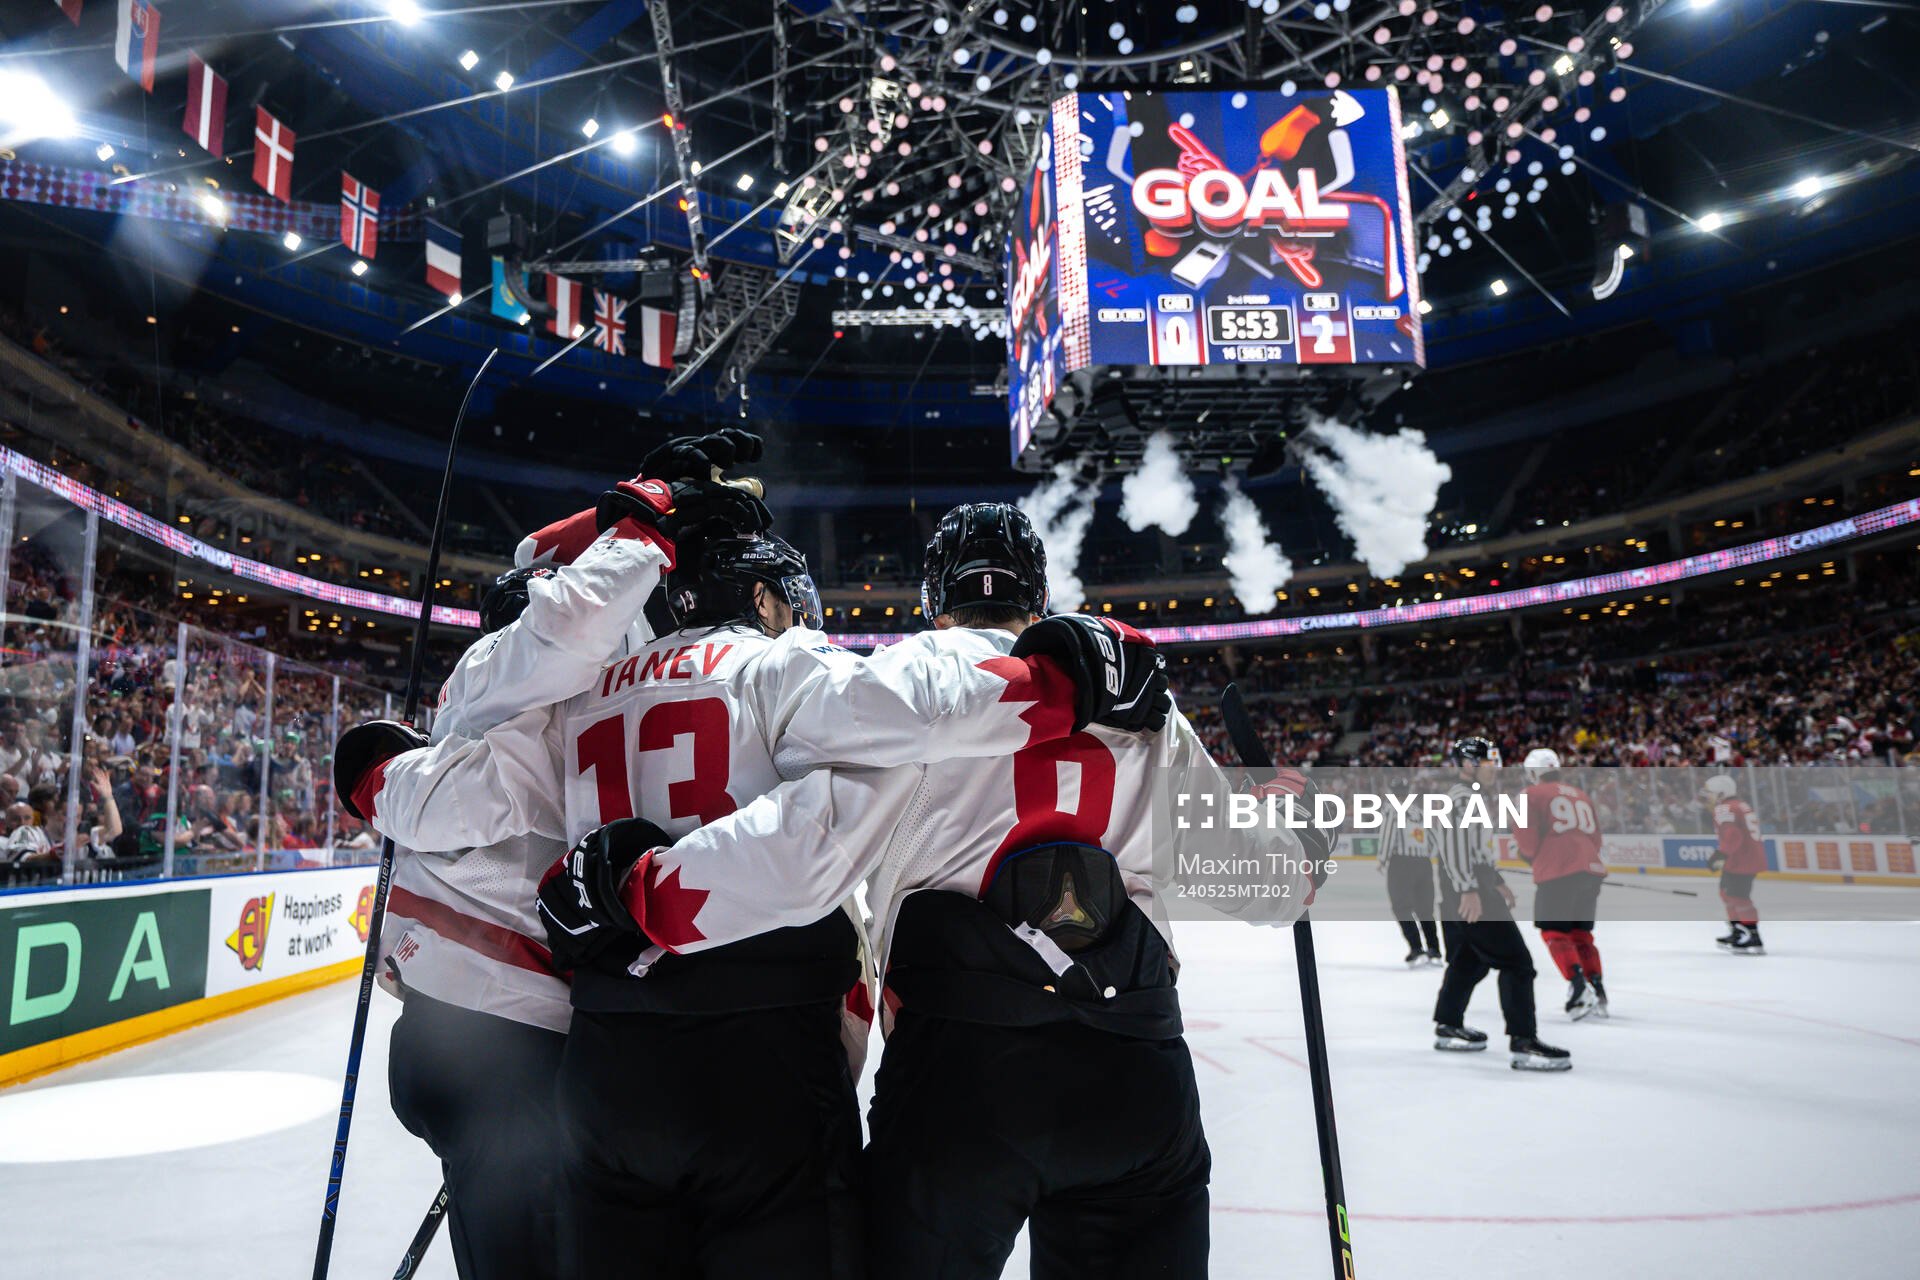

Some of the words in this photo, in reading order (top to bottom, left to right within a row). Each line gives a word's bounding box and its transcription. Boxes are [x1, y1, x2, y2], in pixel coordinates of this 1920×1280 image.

[1131, 168, 1350, 222] GOAL
[1165, 315, 1191, 354] 0
[1221, 311, 1279, 340] 5:53
[1311, 314, 1336, 354] 2
[1788, 518, 1857, 550] CANADA
[983, 574, 993, 596] 8
[679, 590, 696, 623] 13
[602, 642, 735, 698] TANEV
[576, 696, 739, 828] 13
[1549, 795, 1596, 834] 90
[283, 892, 342, 925] Happiness
[288, 933, 302, 956] at
